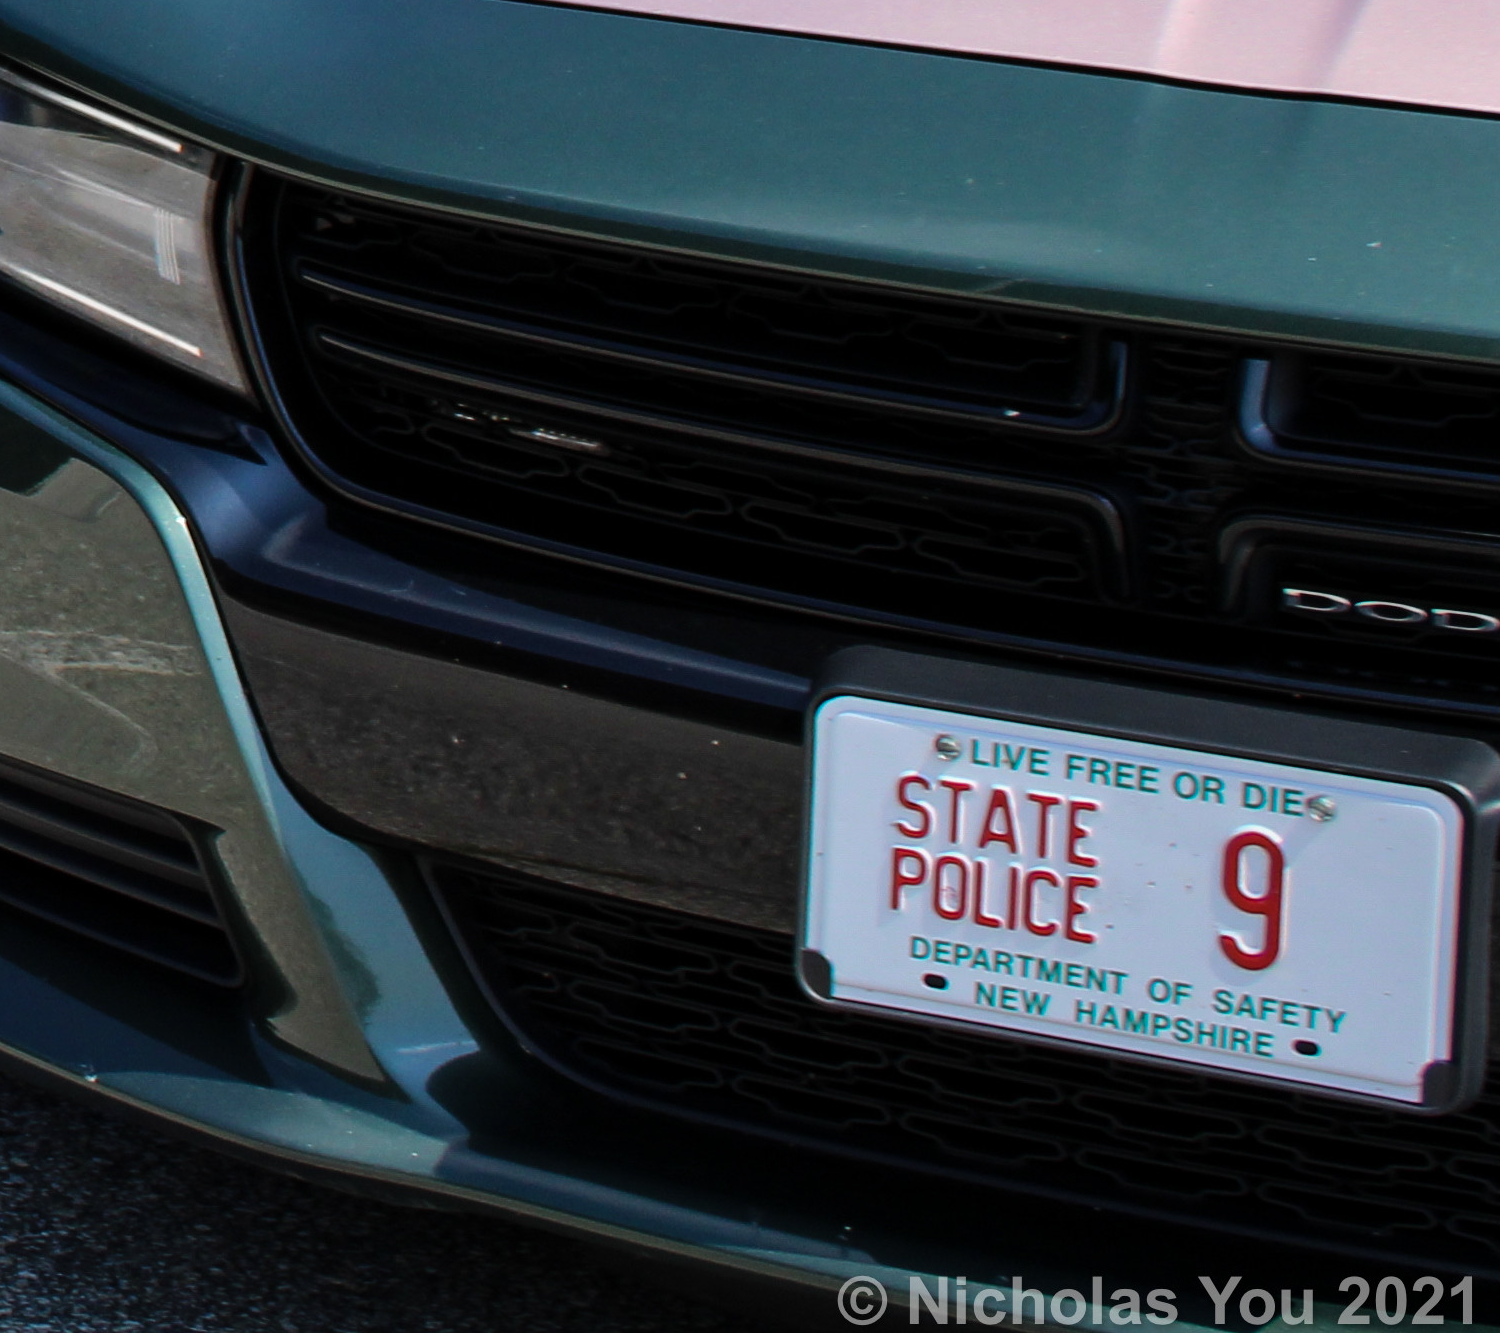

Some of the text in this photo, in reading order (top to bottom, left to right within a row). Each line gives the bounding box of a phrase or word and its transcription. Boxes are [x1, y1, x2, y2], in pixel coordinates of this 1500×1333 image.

[971, 738, 1305, 818] LIVE FREE OR DIE
[890, 844, 1100, 944] POLICE
[892, 774, 1283, 971] STATE 9
[908, 935, 1346, 1034] DEPARTMENT OF SAFETY
[974, 980, 1275, 1058] NEW HAMPSHIRE
